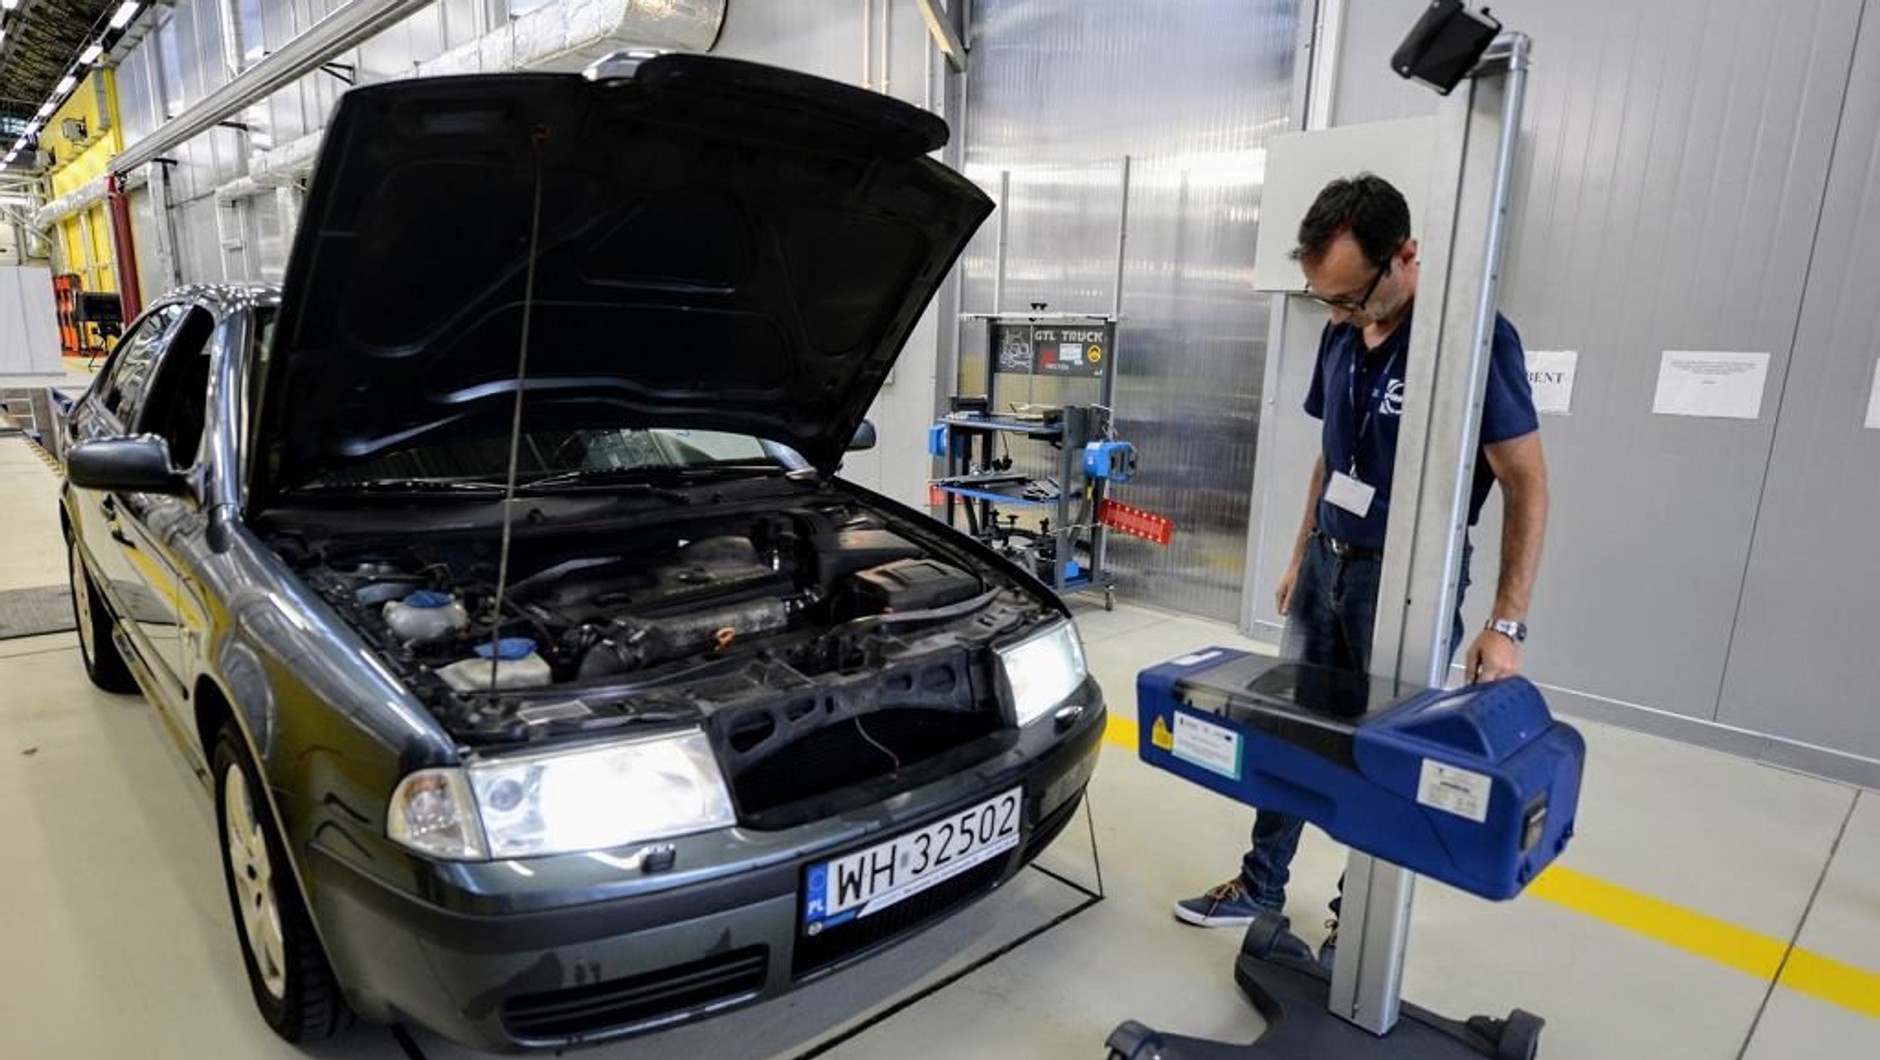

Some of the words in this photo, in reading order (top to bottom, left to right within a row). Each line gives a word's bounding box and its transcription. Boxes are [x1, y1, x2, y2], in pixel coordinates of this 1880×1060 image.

[1034, 330, 1056, 341] GTL
[1061, 330, 1103, 342] TRUCK
[838, 844, 897, 906] WH
[911, 796, 1015, 875] 32502
[807, 898, 824, 916] PL
